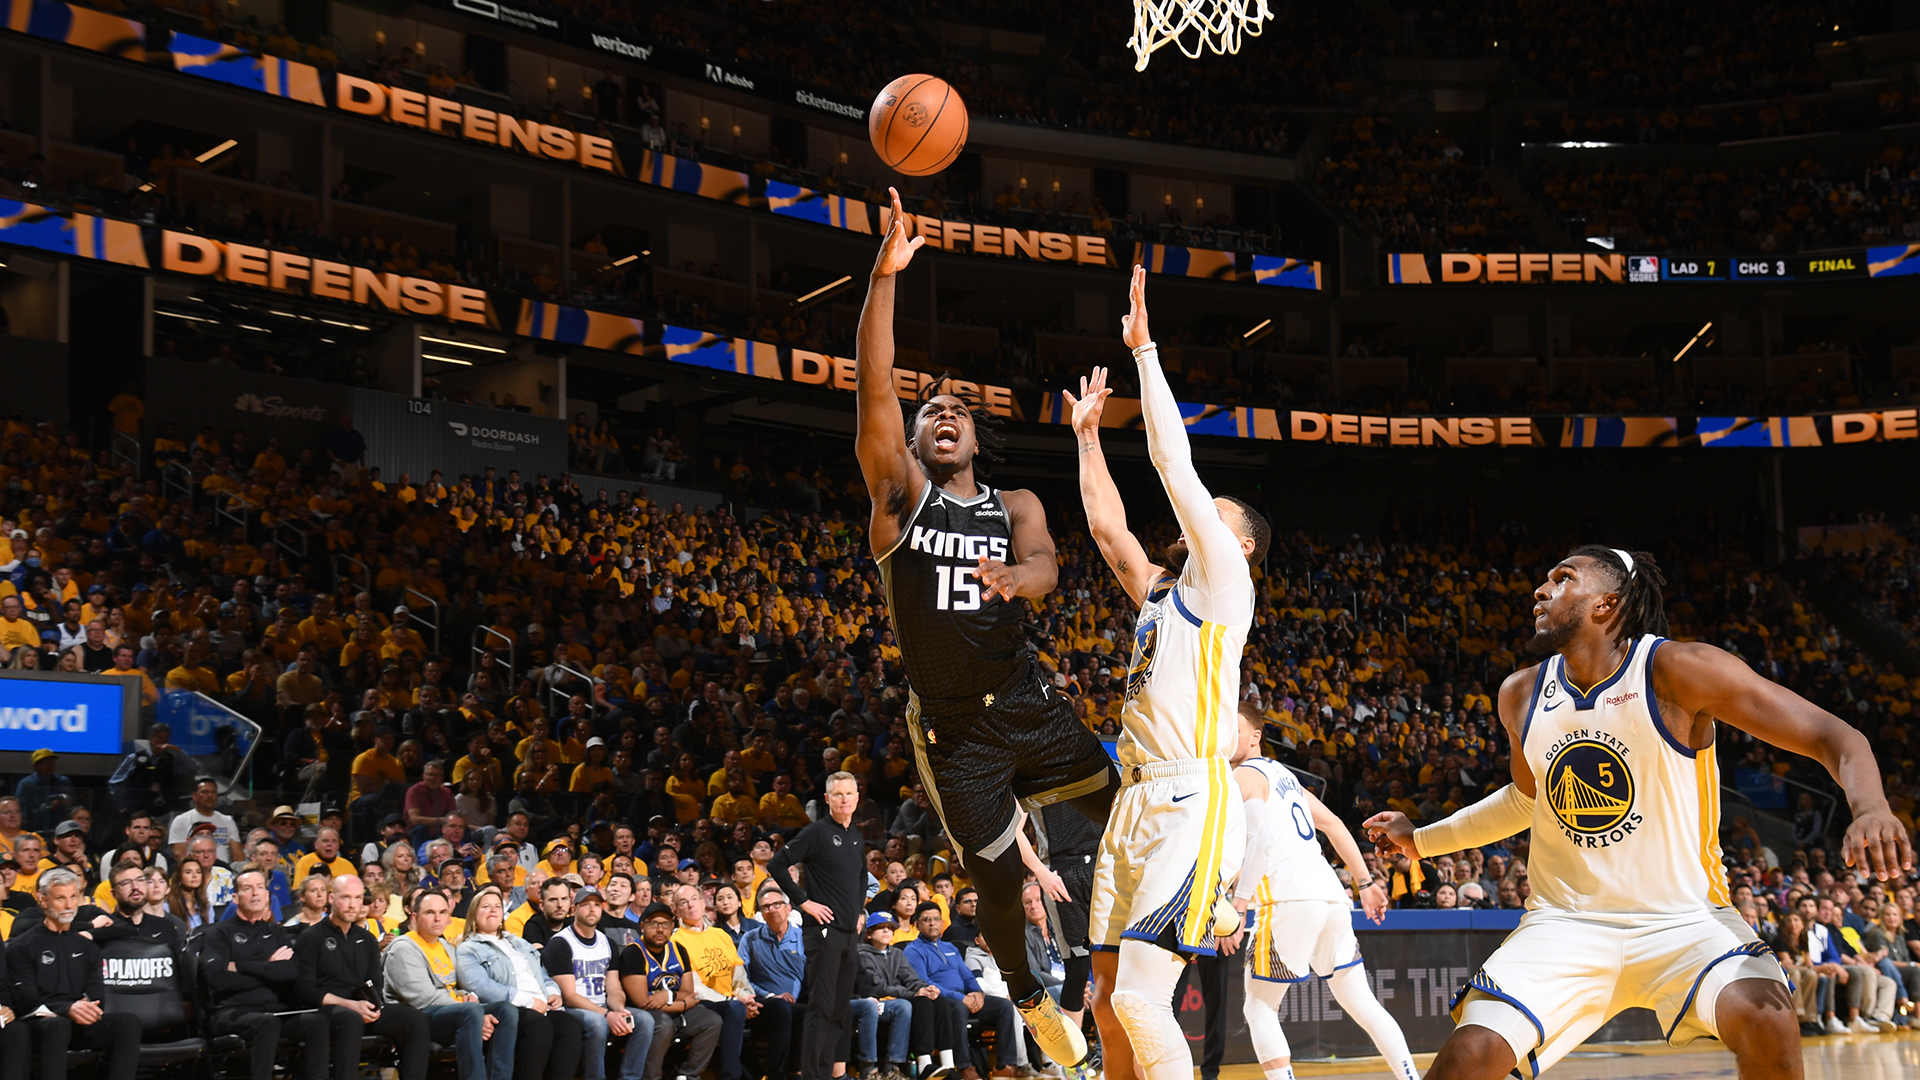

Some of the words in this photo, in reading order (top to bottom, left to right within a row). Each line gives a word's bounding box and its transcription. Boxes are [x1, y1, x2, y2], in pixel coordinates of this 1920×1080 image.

[591, 33, 650, 60] verizon
[724, 72, 754, 90] Adobe
[796, 90, 864, 119] ticketmaster
[336, 72, 613, 171] DEFENSE
[162, 229, 487, 325] DEFENSE
[1441, 253, 1622, 282] DEFEN
[1629, 273, 1658, 282] SCORES
[1671, 263, 1698, 274] LAD
[1706, 261, 1716, 276] 7
[1738, 262, 1769, 274] CHC
[1776, 261, 1785, 275] 3
[1809, 259, 1855, 273] FINAL
[791, 348, 1012, 417] DEENSE
[262, 395, 328, 422] Sports
[407, 400, 431, 415] 104
[471, 426, 539, 445] DOORDASH
[1290, 410, 1532, 445] DEFENSE
[1831, 409, 1918, 444] DE
[471, 439, 492, 450] Radio
[493, 441, 516, 452] Booth
[910, 525, 1008, 563] KINGS
[936, 565, 981, 610] 15
[1606, 691, 1639, 706] Rakuten
[1545, 728, 1589, 761] GOLDEN
[1594, 730, 1630, 757] STATE
[1598, 762, 1615, 788] 5
[1291, 802, 1314, 841] 0
[108, 957, 173, 979] PLAYOFFS
